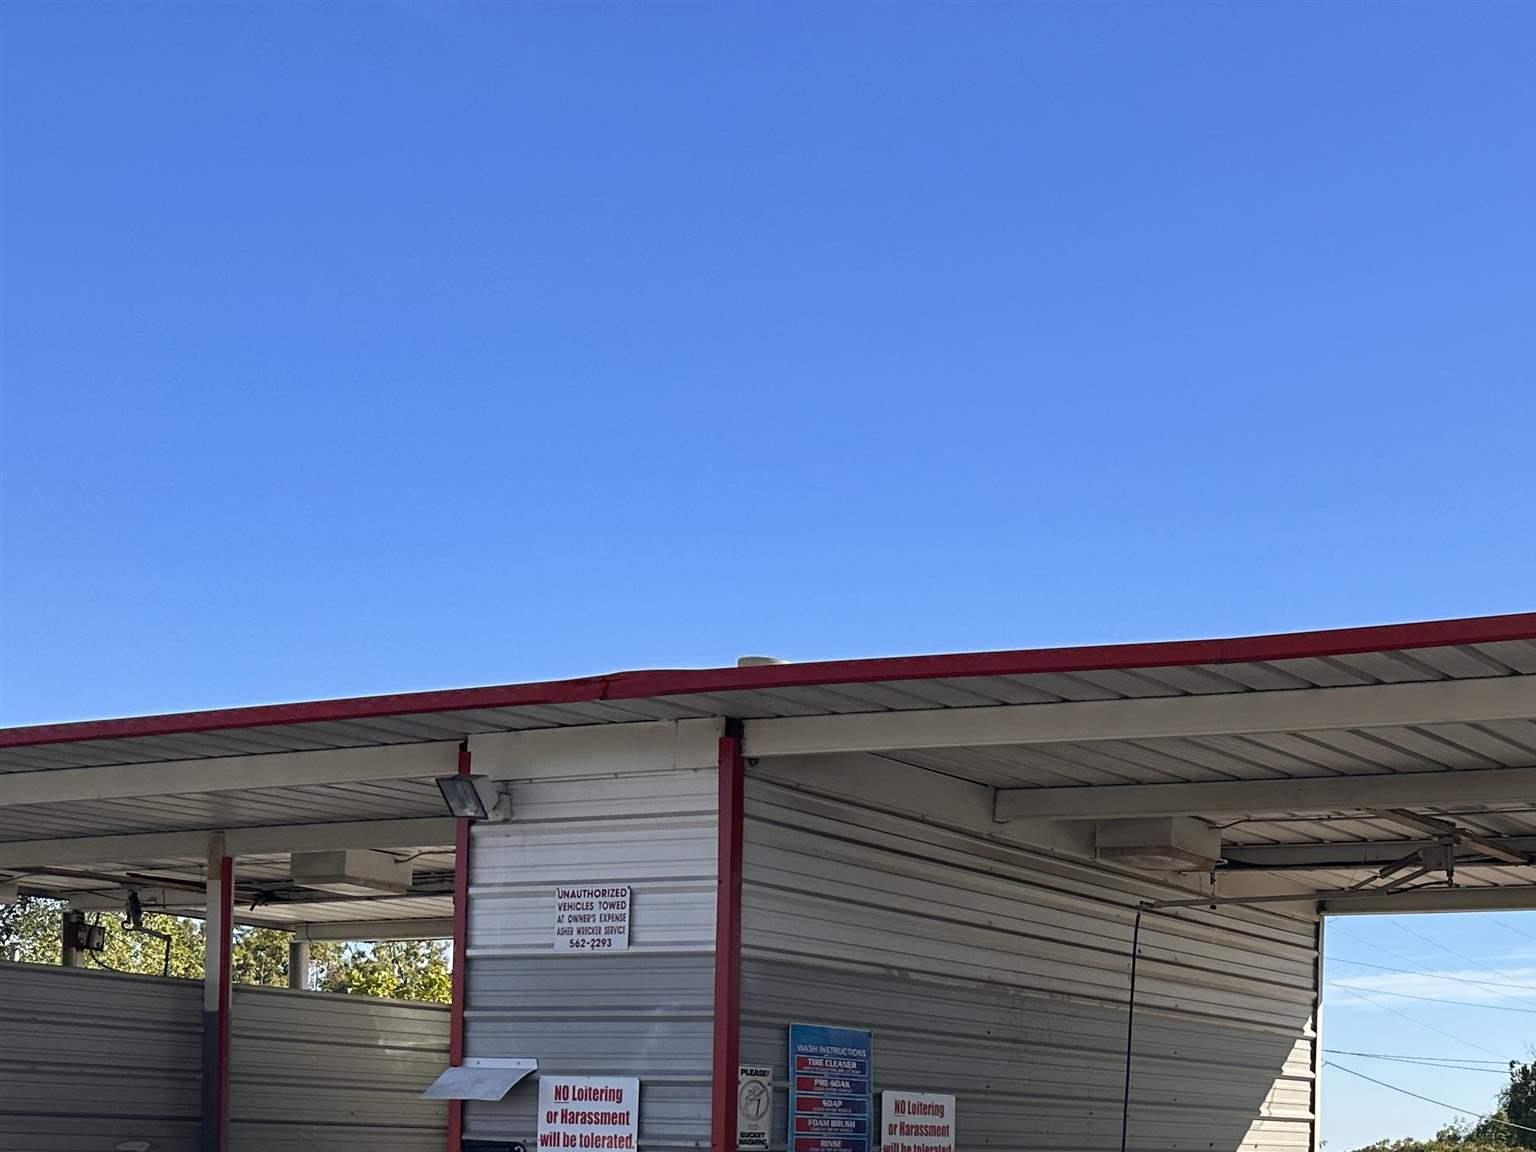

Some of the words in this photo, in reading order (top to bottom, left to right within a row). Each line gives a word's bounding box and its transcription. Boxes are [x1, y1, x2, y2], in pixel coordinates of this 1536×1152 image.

[557, 888, 627, 899] UNAUTHORIZED
[558, 901, 594, 911] VEHICLES
[598, 900, 627, 911] TOWED
[557, 914, 565, 923] AT
[599, 913, 627, 923] EXPENSE
[604, 925, 626, 935] SERVICE
[569, 938, 612, 948] 562-2293
[798, 1044, 817, 1054] WASH
[819, 1045, 866, 1057] INSTRUCTIONS
[740, 1068, 770, 1077] PLEASE!
[554, 1085, 570, 1101] NO
[572, 1085, 623, 1104] Loitering
[822, 1099, 843, 1108] SOAP
[894, 1100, 906, 1115] NO
[907, 1101, 945, 1118] Loitering
[546, 1110, 559, 1124] or
[560, 1108, 631, 1126] Harassment
[888, 1123, 898, 1136] or
[899, 1121, 950, 1137] Harassment
[540, 1131, 560, 1148] will
[562, 1131, 577, 1148] be
[579, 1132, 635, 1150] tolerated.
[820, 1139, 842, 1148] RINSE
